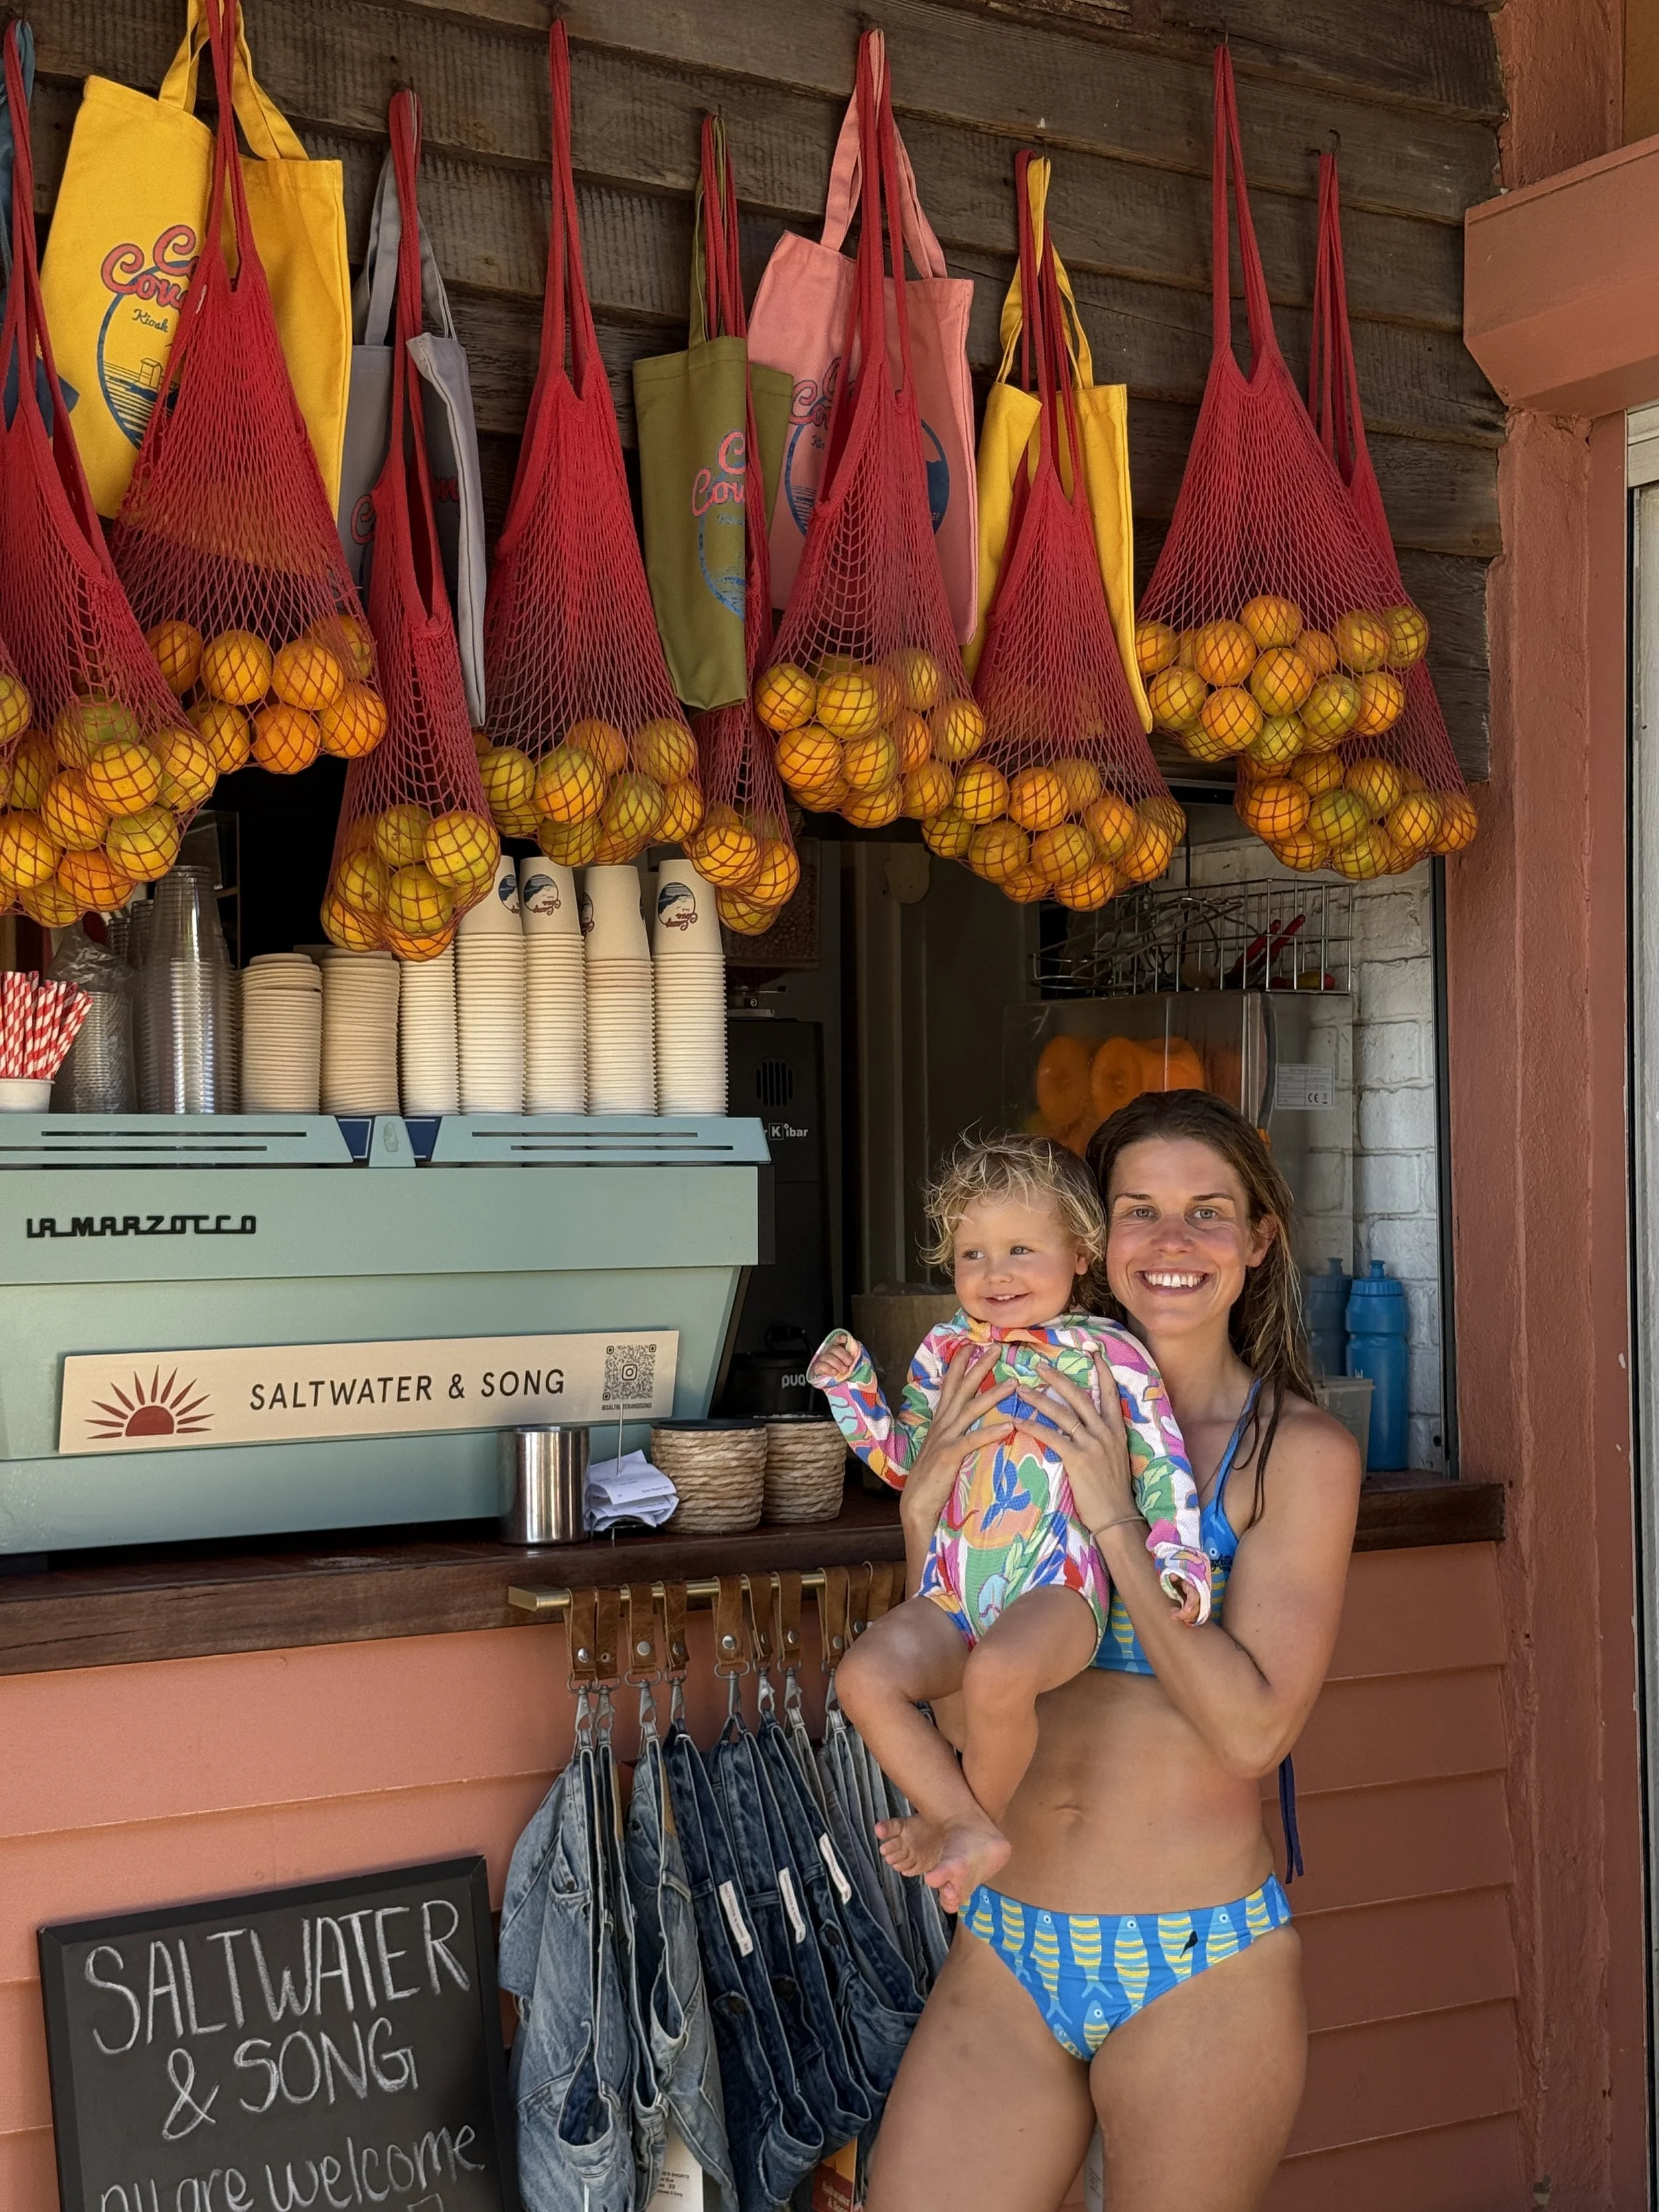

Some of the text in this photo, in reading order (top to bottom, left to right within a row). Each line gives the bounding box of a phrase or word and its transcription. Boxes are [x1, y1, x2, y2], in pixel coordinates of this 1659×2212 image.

[132, 309, 168, 332] Kiosk
[250, 1368, 565, 1410] SALTWATER & SONG
[85, 1900, 470, 2054] SALTWATER
[162, 2017, 419, 2140] & SONG
[177, 2168, 254, 2212] are
[265, 2125, 486, 2212] welcome
